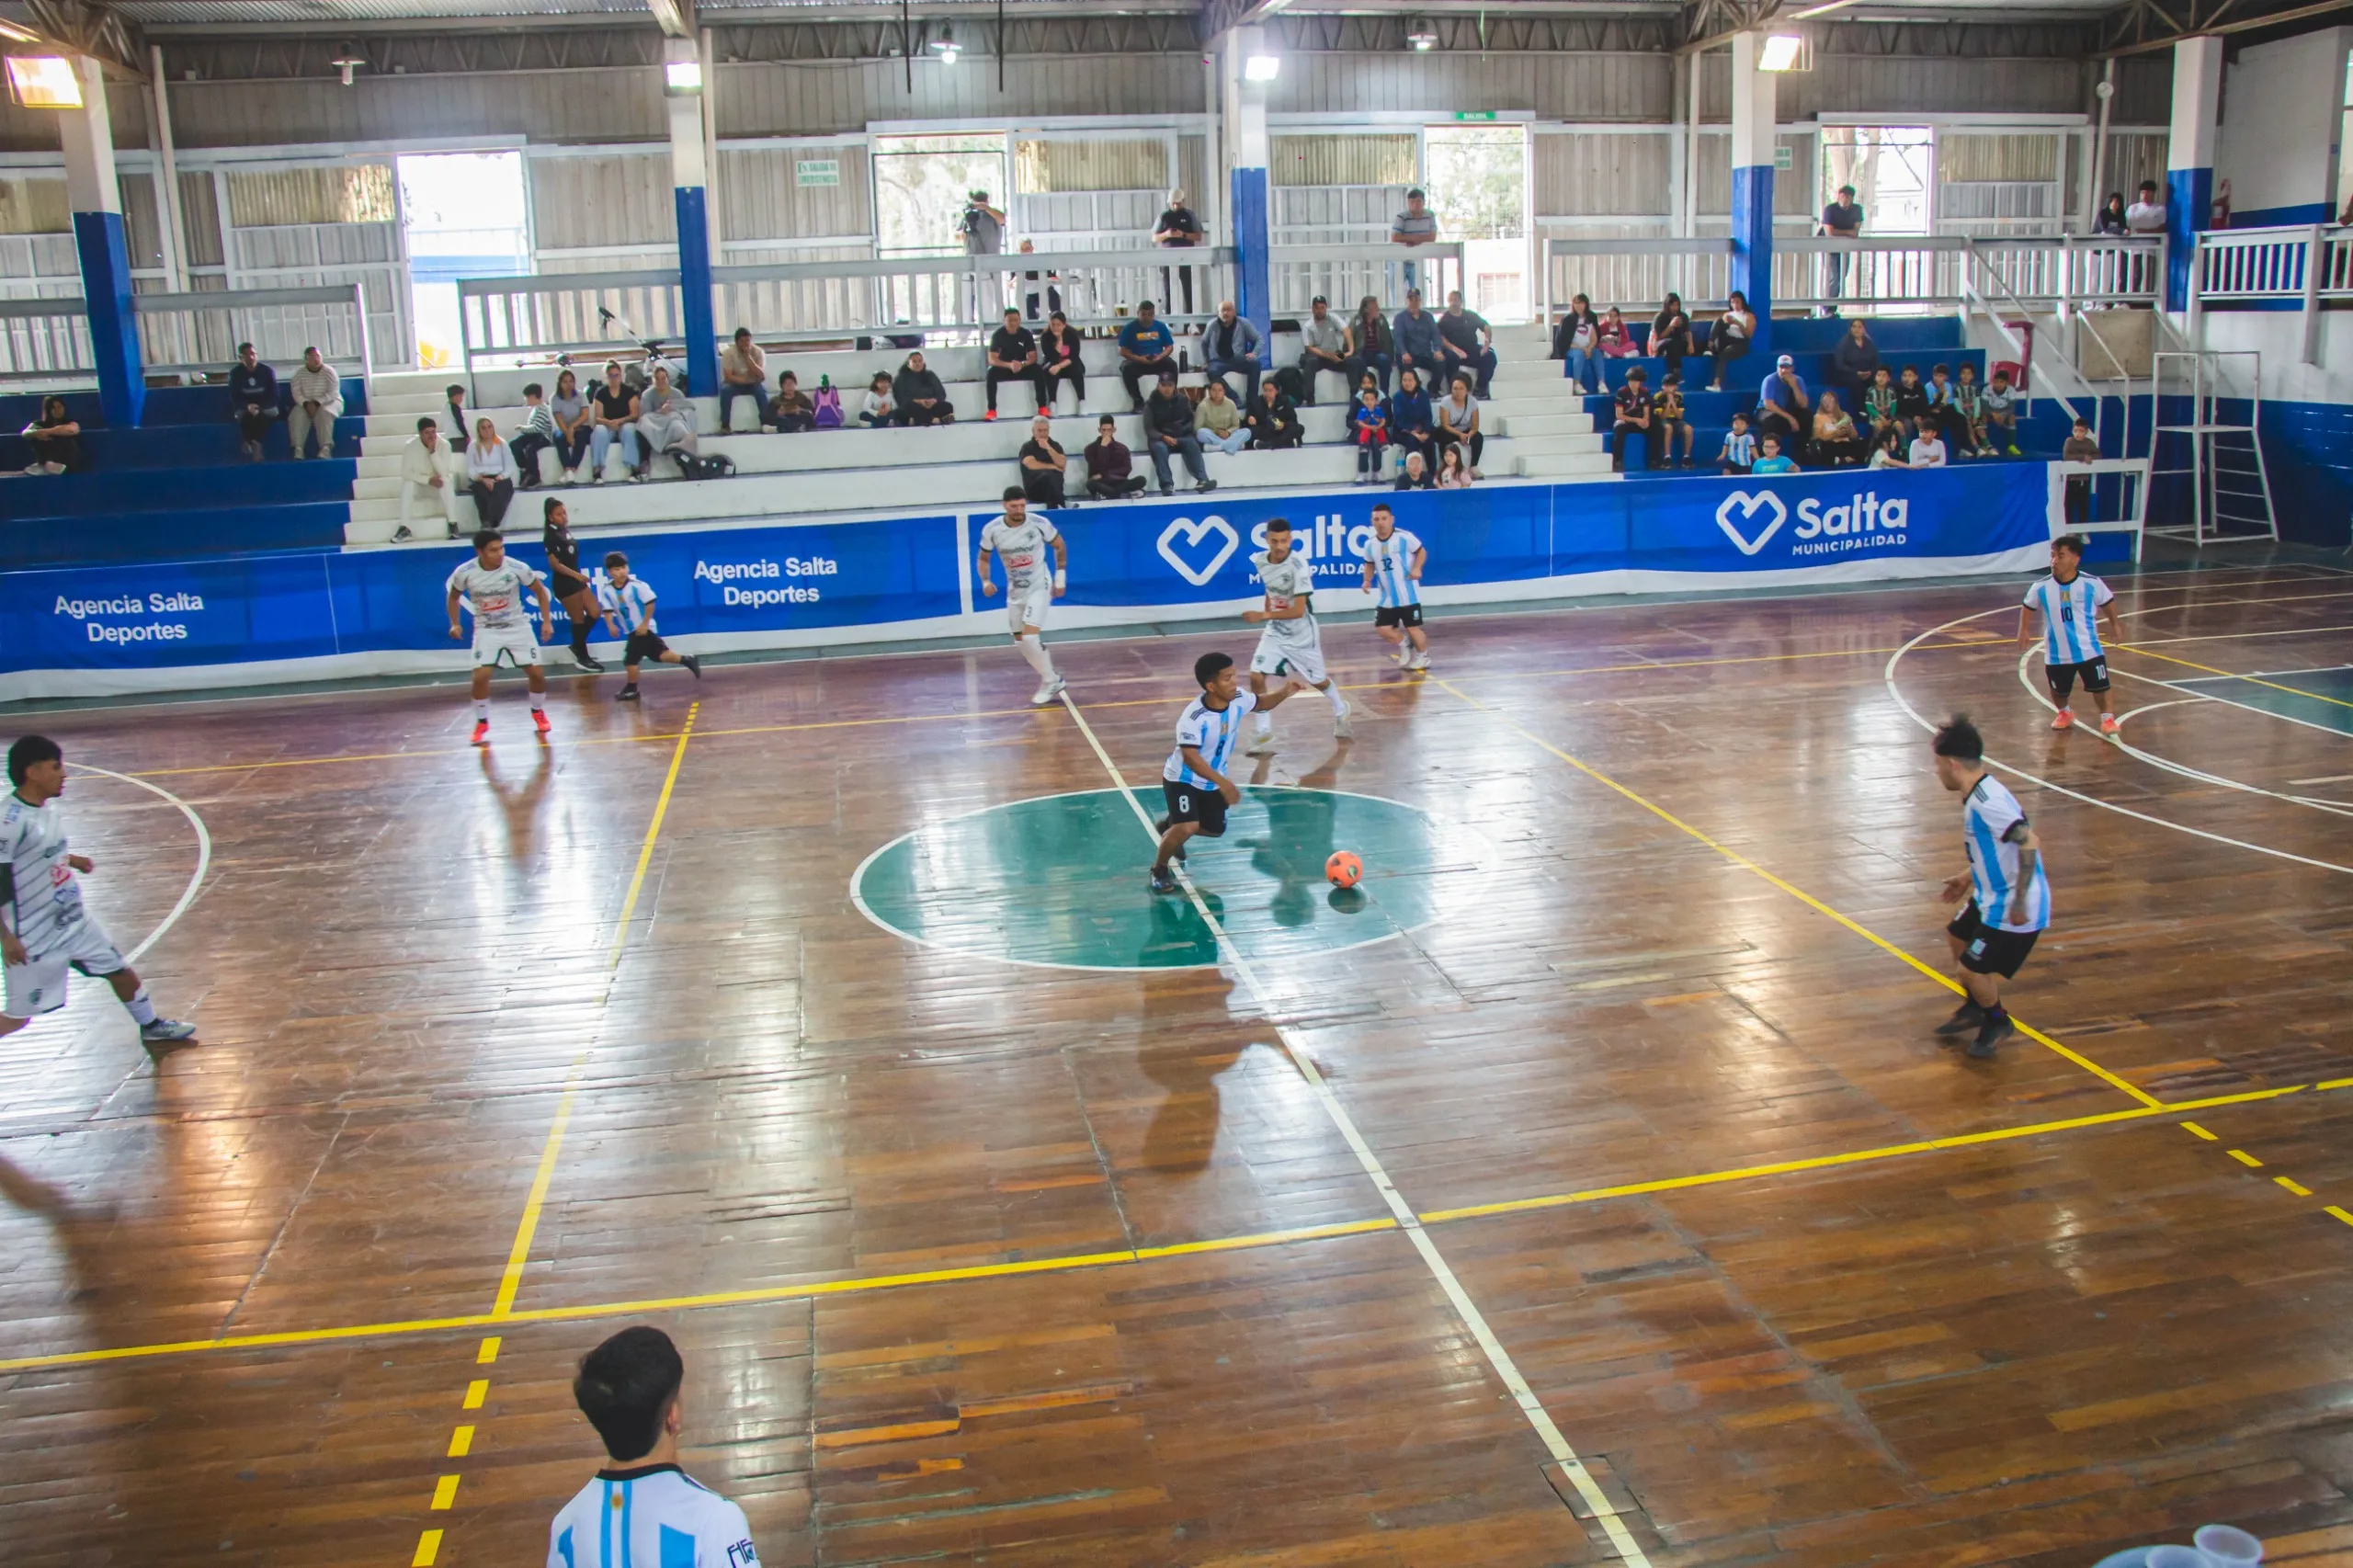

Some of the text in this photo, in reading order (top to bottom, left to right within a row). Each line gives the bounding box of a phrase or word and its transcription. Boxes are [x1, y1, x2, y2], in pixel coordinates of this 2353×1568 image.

[1794, 491, 1908, 540] Salta
[1792, 534, 1907, 555] MUNICIPALIDAD
[694, 556, 838, 584] Agencia Salta
[54, 592, 204, 619] Agencia Salta
[723, 585, 820, 608] Deportes
[2061, 607, 2073, 623] 10
[87, 621, 188, 646] Deportes
[2095, 664, 2107, 680] 10
[1178, 795, 1190, 812] 8
